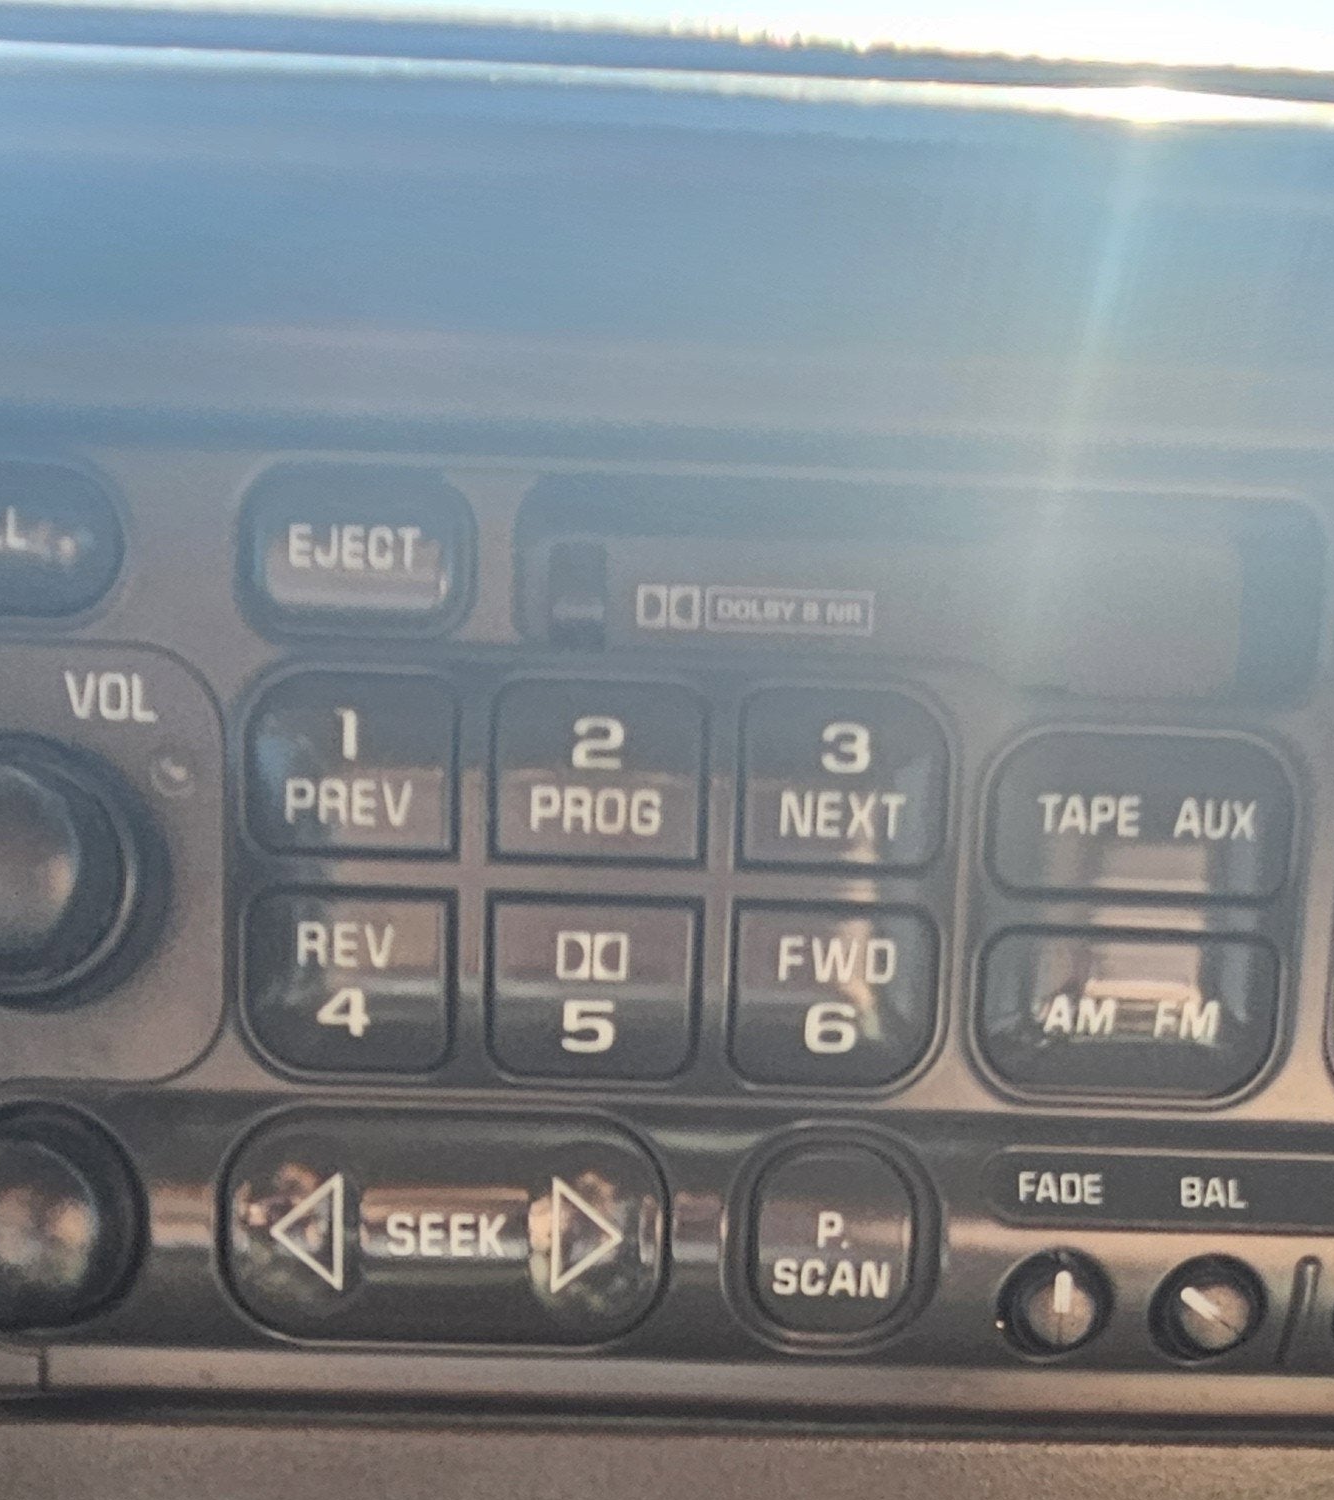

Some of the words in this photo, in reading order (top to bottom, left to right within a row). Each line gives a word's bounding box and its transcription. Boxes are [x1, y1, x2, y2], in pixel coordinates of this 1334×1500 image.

[287, 523, 422, 571] EJECT
[717, 599, 797, 623] DOLBY
[64, 670, 159, 723] VOL
[333, 707, 359, 761] 1
[571, 716, 625, 770] 2
[820, 722, 871, 774] 3
[284, 778, 413, 828] PREV
[529, 784, 663, 836] PROG
[779, 790, 907, 841] NEXT
[1037, 793, 1142, 838] TAPE
[1173, 797, 1258, 842] AUX
[296, 920, 395, 970] REV
[777, 935, 898, 986] FWD
[316, 987, 370, 1038] 4
[561, 1000, 617, 1054] 5
[803, 1004, 859, 1055] 6
[1043, 994, 1118, 1036] AM
[1153, 1000, 1222, 1041] FM
[1017, 1170, 1104, 1208] FADE
[1179, 1175, 1248, 1211] BAL
[385, 1212, 508, 1258] SEEK
[815, 1210, 851, 1250] P.
[771, 1258, 891, 1299] SCAN
